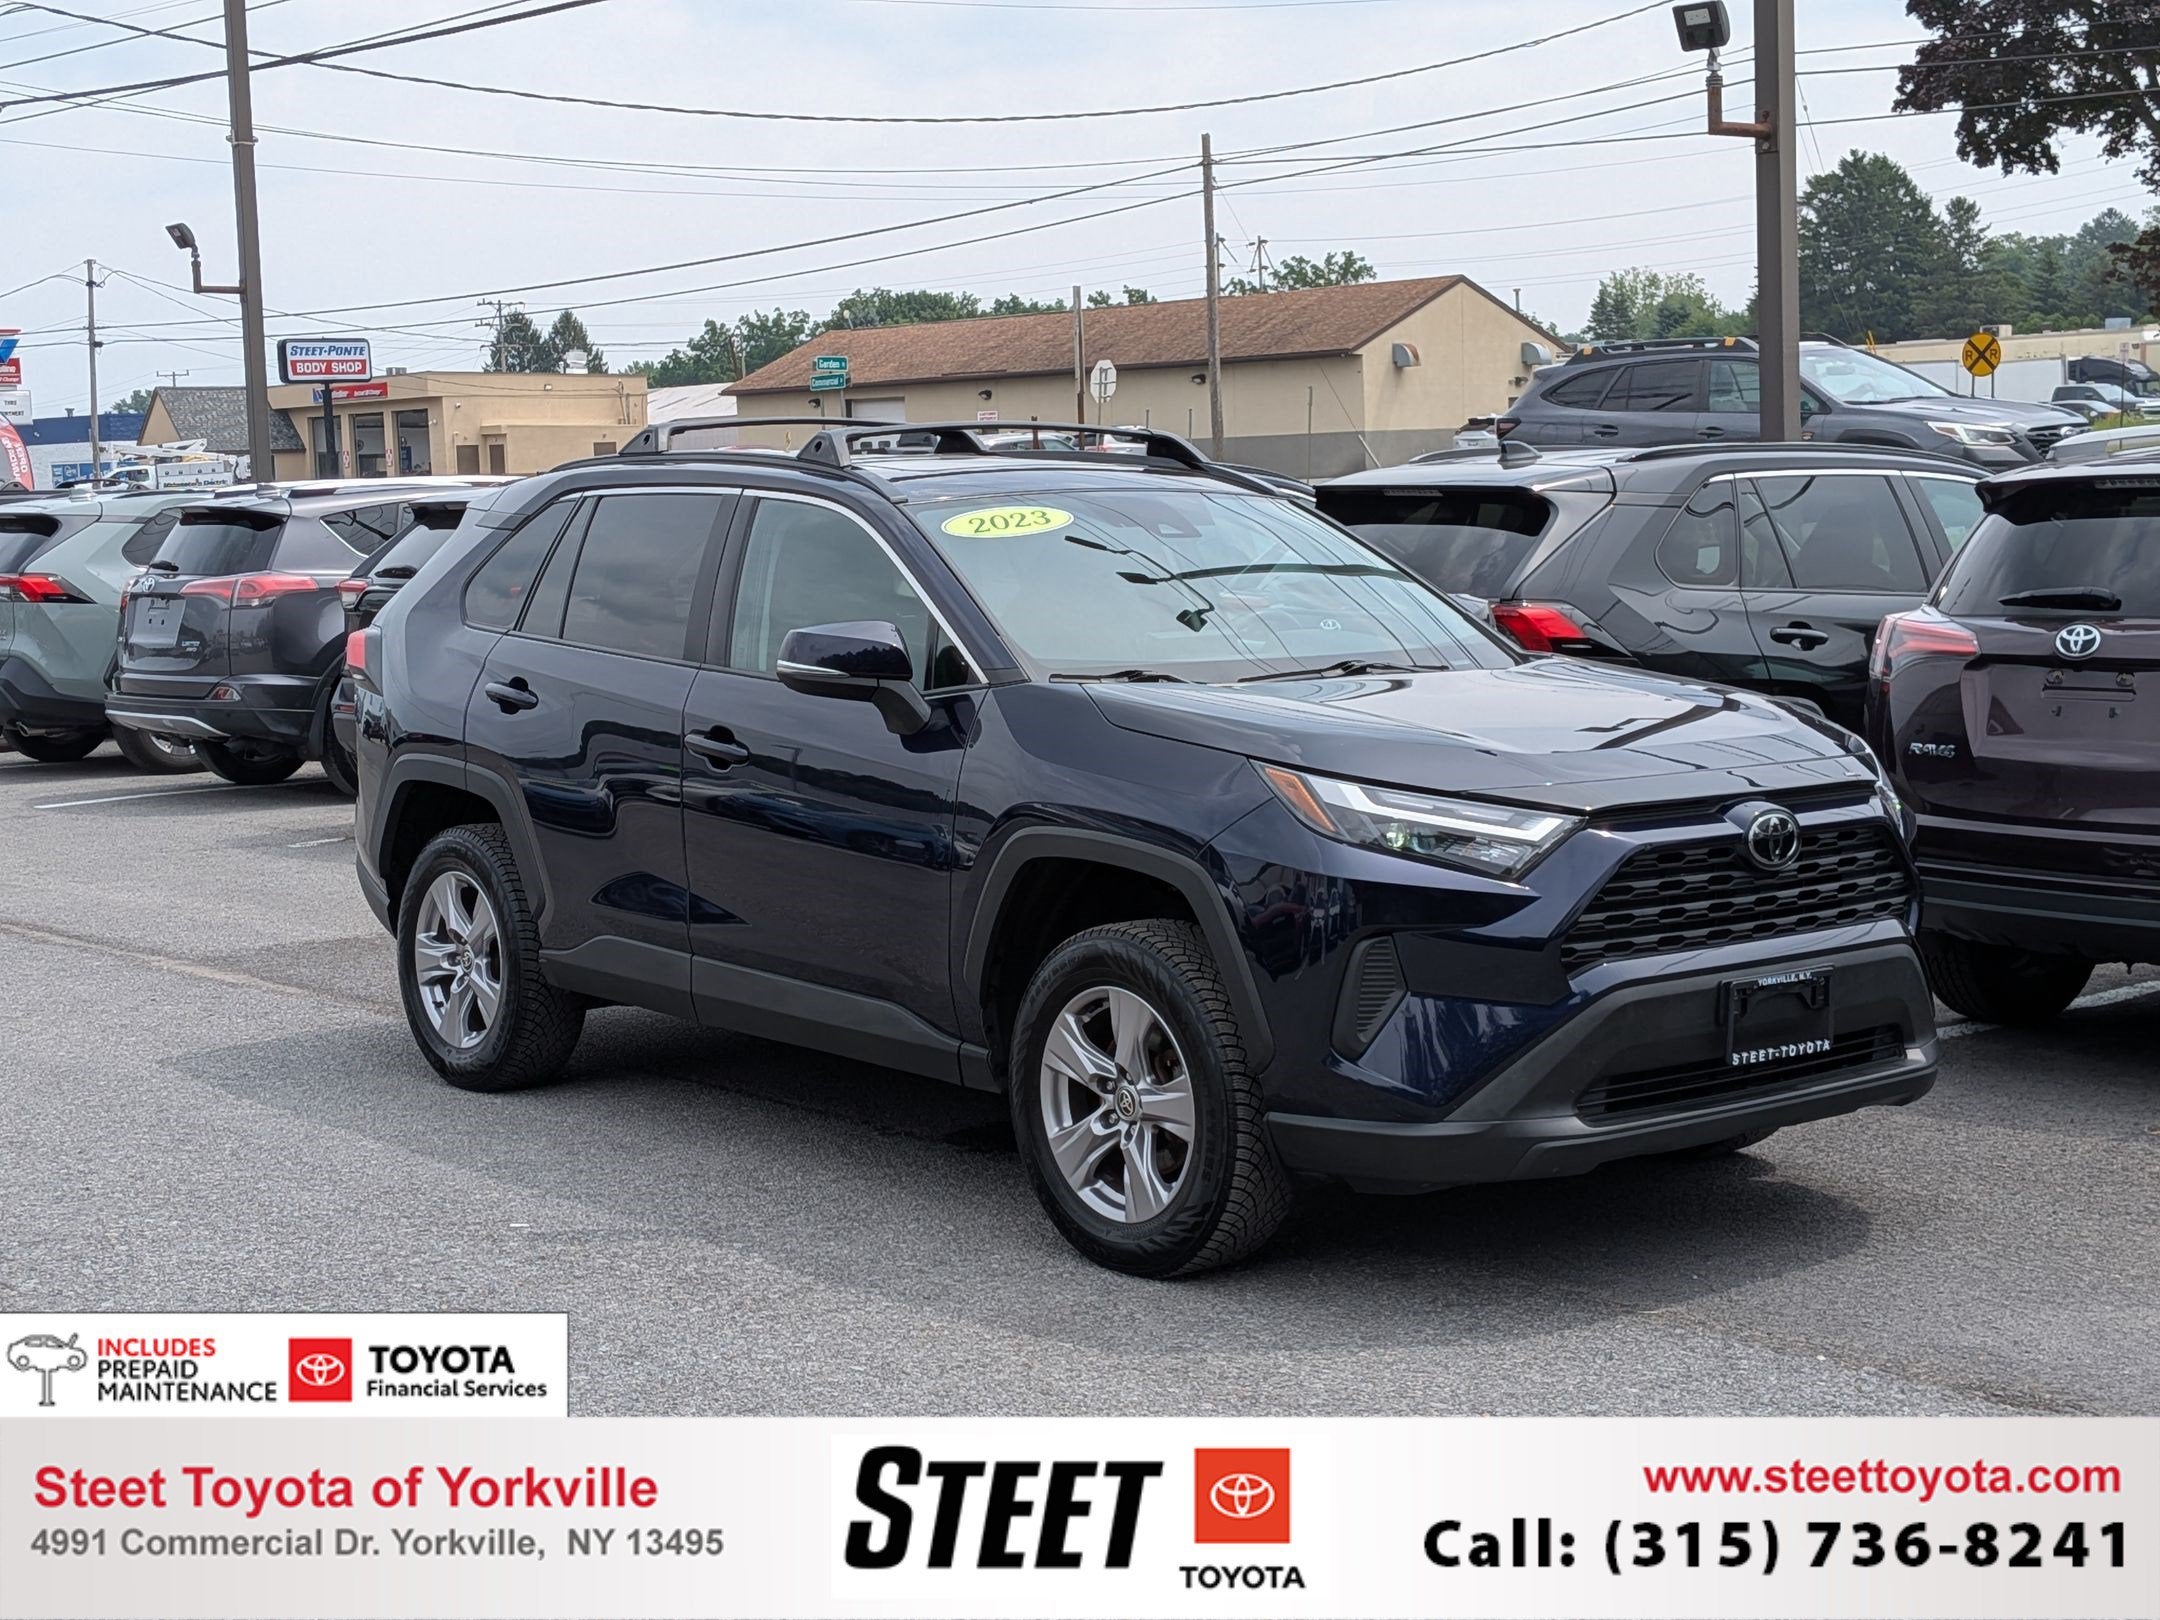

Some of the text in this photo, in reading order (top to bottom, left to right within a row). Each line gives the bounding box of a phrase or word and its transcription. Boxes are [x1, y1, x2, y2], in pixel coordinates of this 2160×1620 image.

[296, 361, 362, 374] BODY SHOP
[968, 510, 1052, 534] 2023
[1731, 1038, 1832, 1066] STEET-TOYOTA
